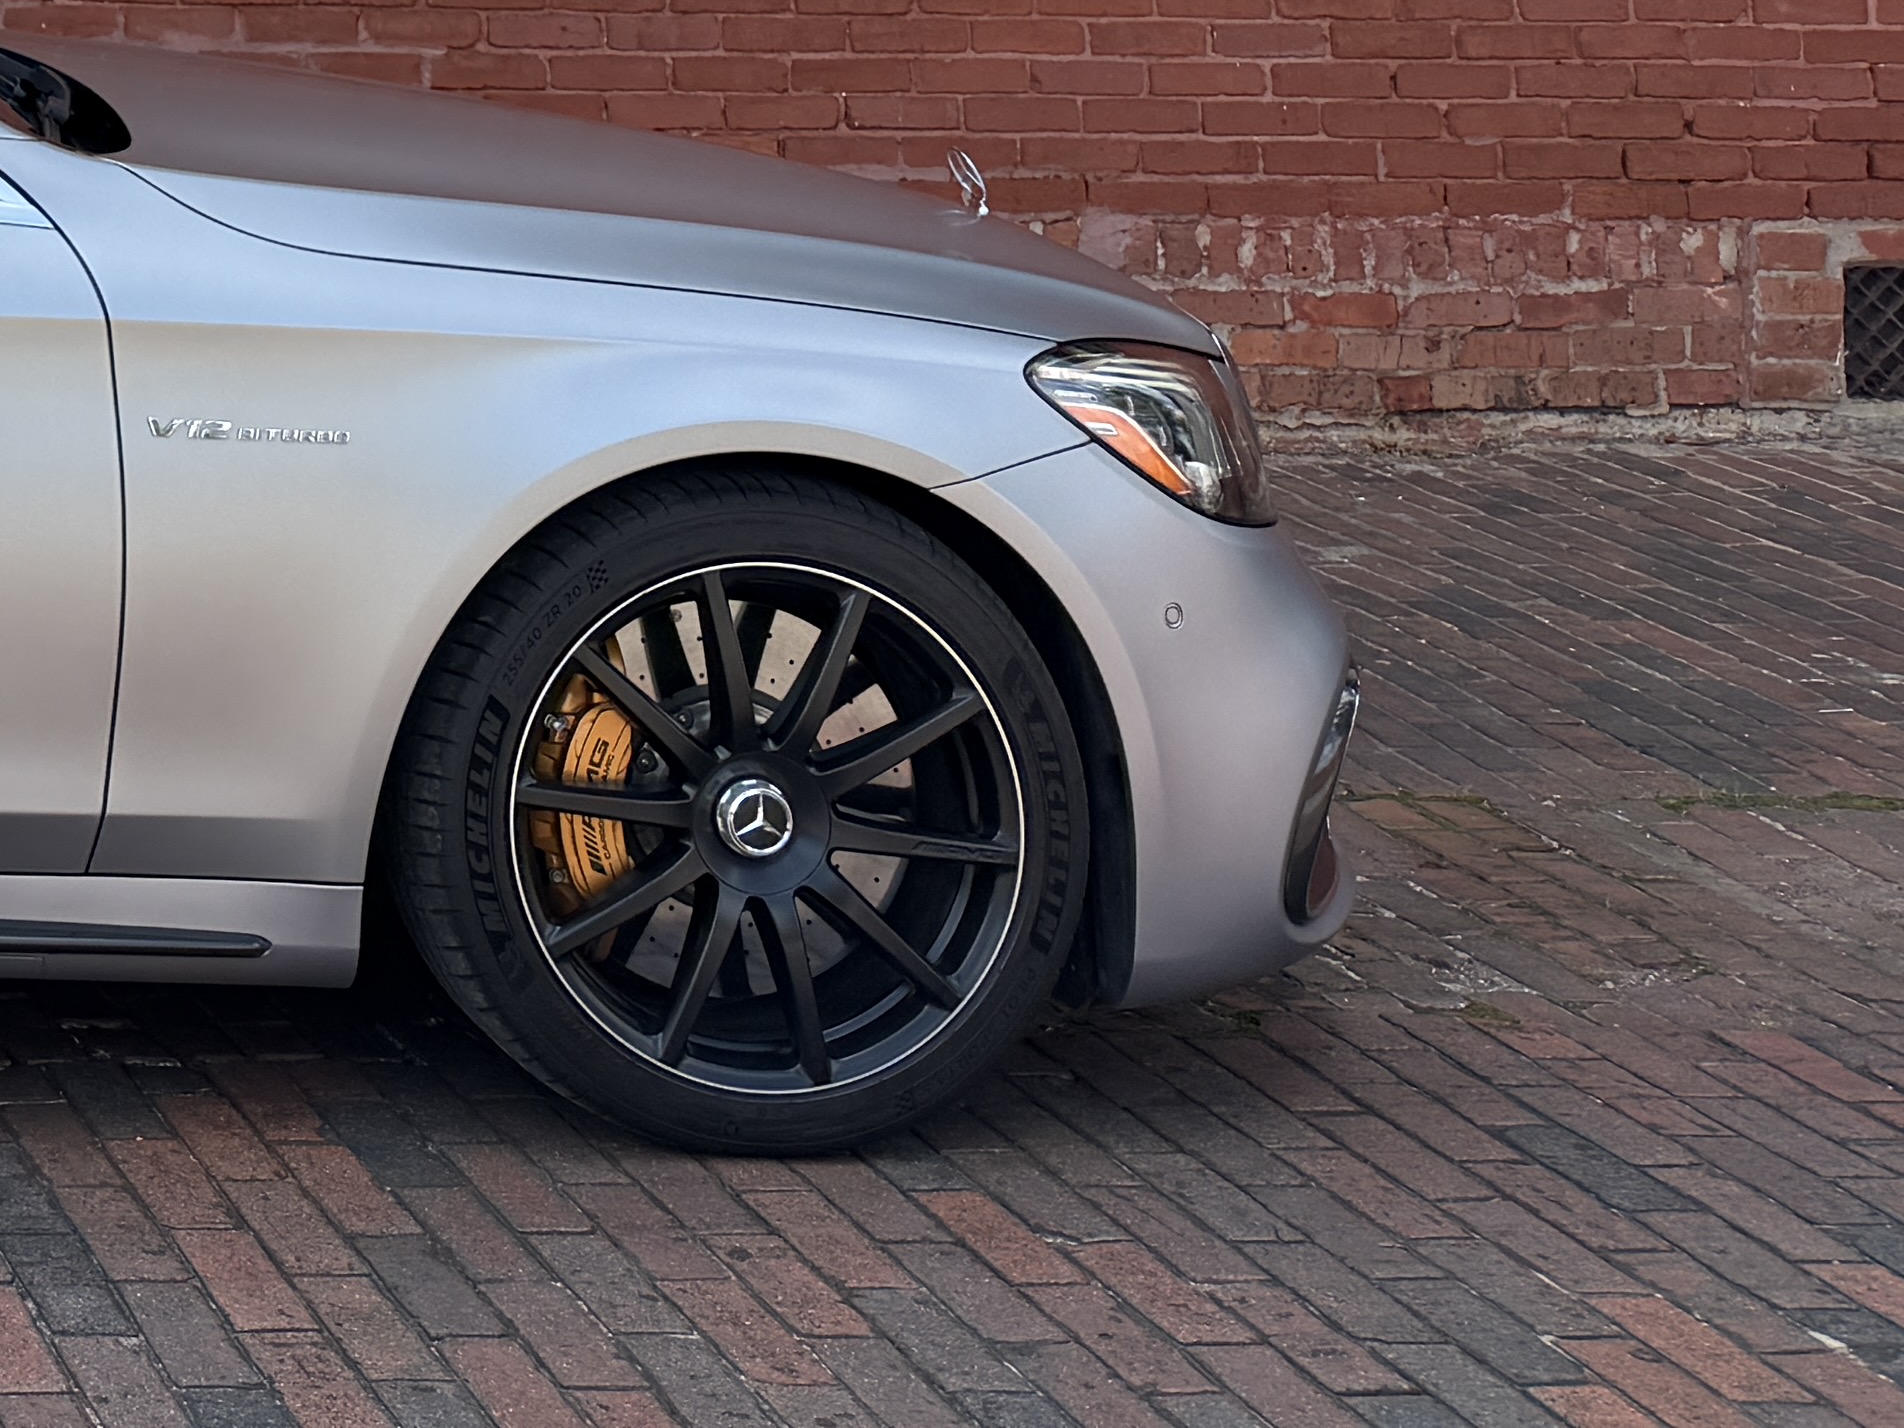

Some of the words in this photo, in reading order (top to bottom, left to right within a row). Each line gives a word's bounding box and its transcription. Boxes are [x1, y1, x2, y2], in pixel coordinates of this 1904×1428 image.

[147, 416, 232, 440] V12
[467, 708, 507, 933] MICHELIN
[1026, 721, 1071, 938] MICHELIN
